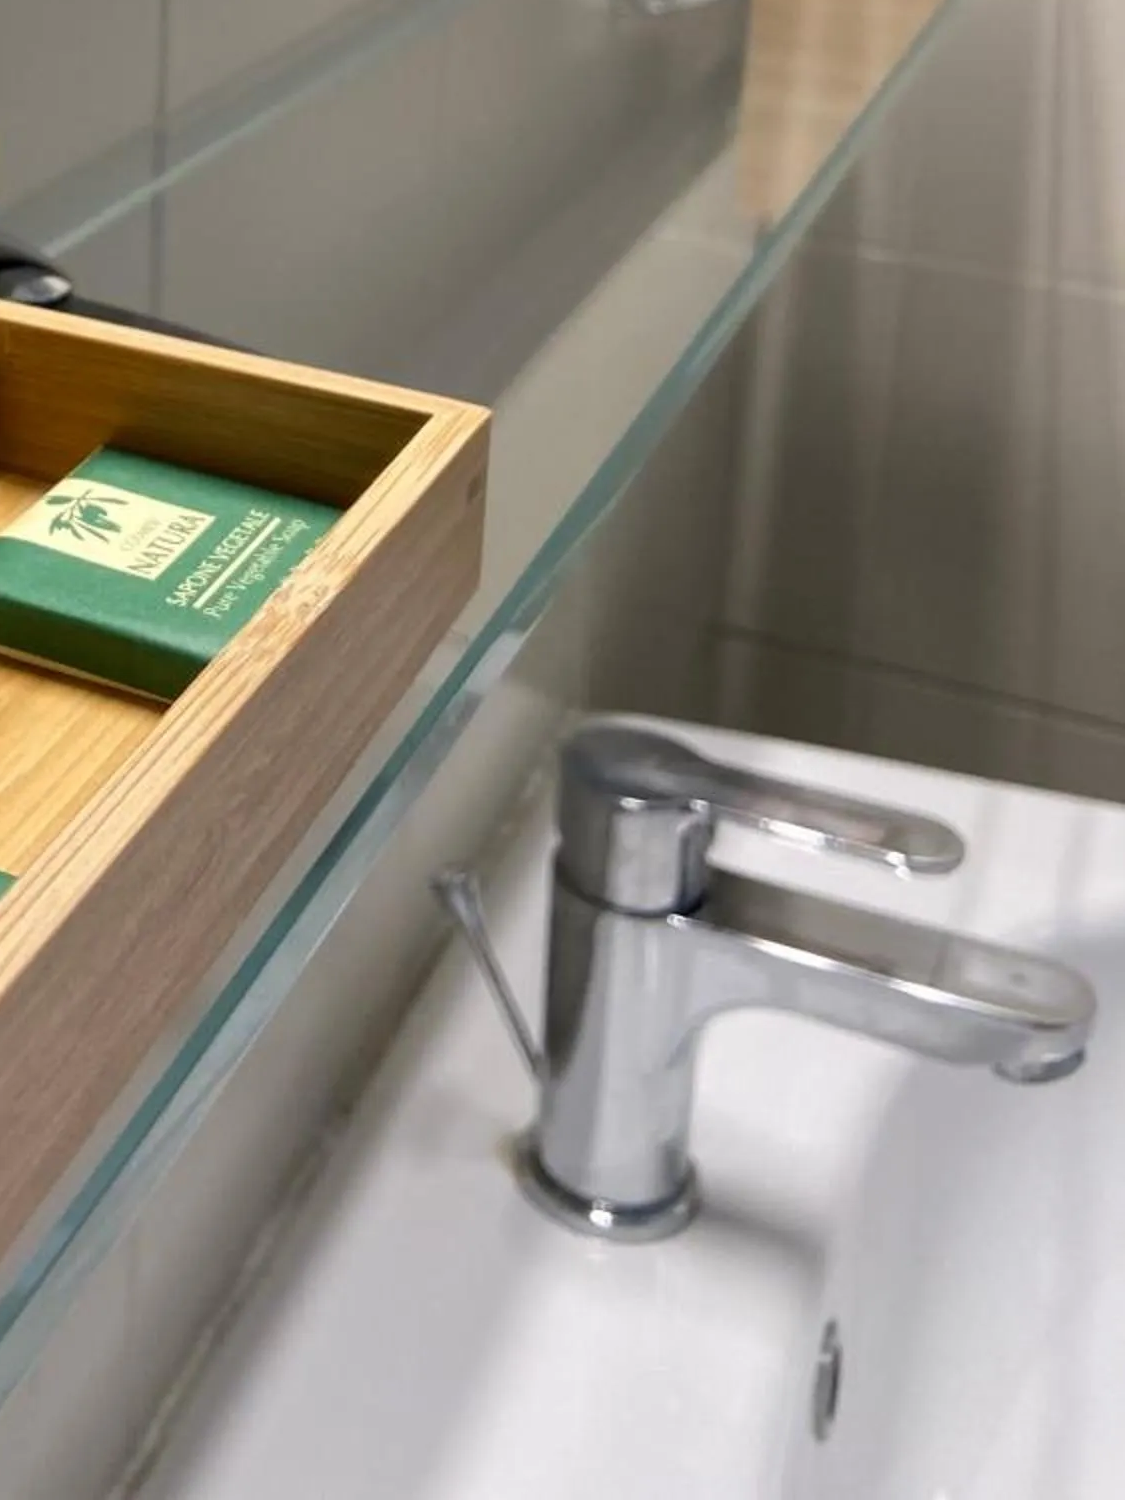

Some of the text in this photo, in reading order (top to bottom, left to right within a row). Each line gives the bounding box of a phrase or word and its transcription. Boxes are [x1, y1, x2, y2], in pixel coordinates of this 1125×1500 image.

[125, 514, 207, 576] NATURA
[165, 508, 271, 608] SAPONE VEGETALE
